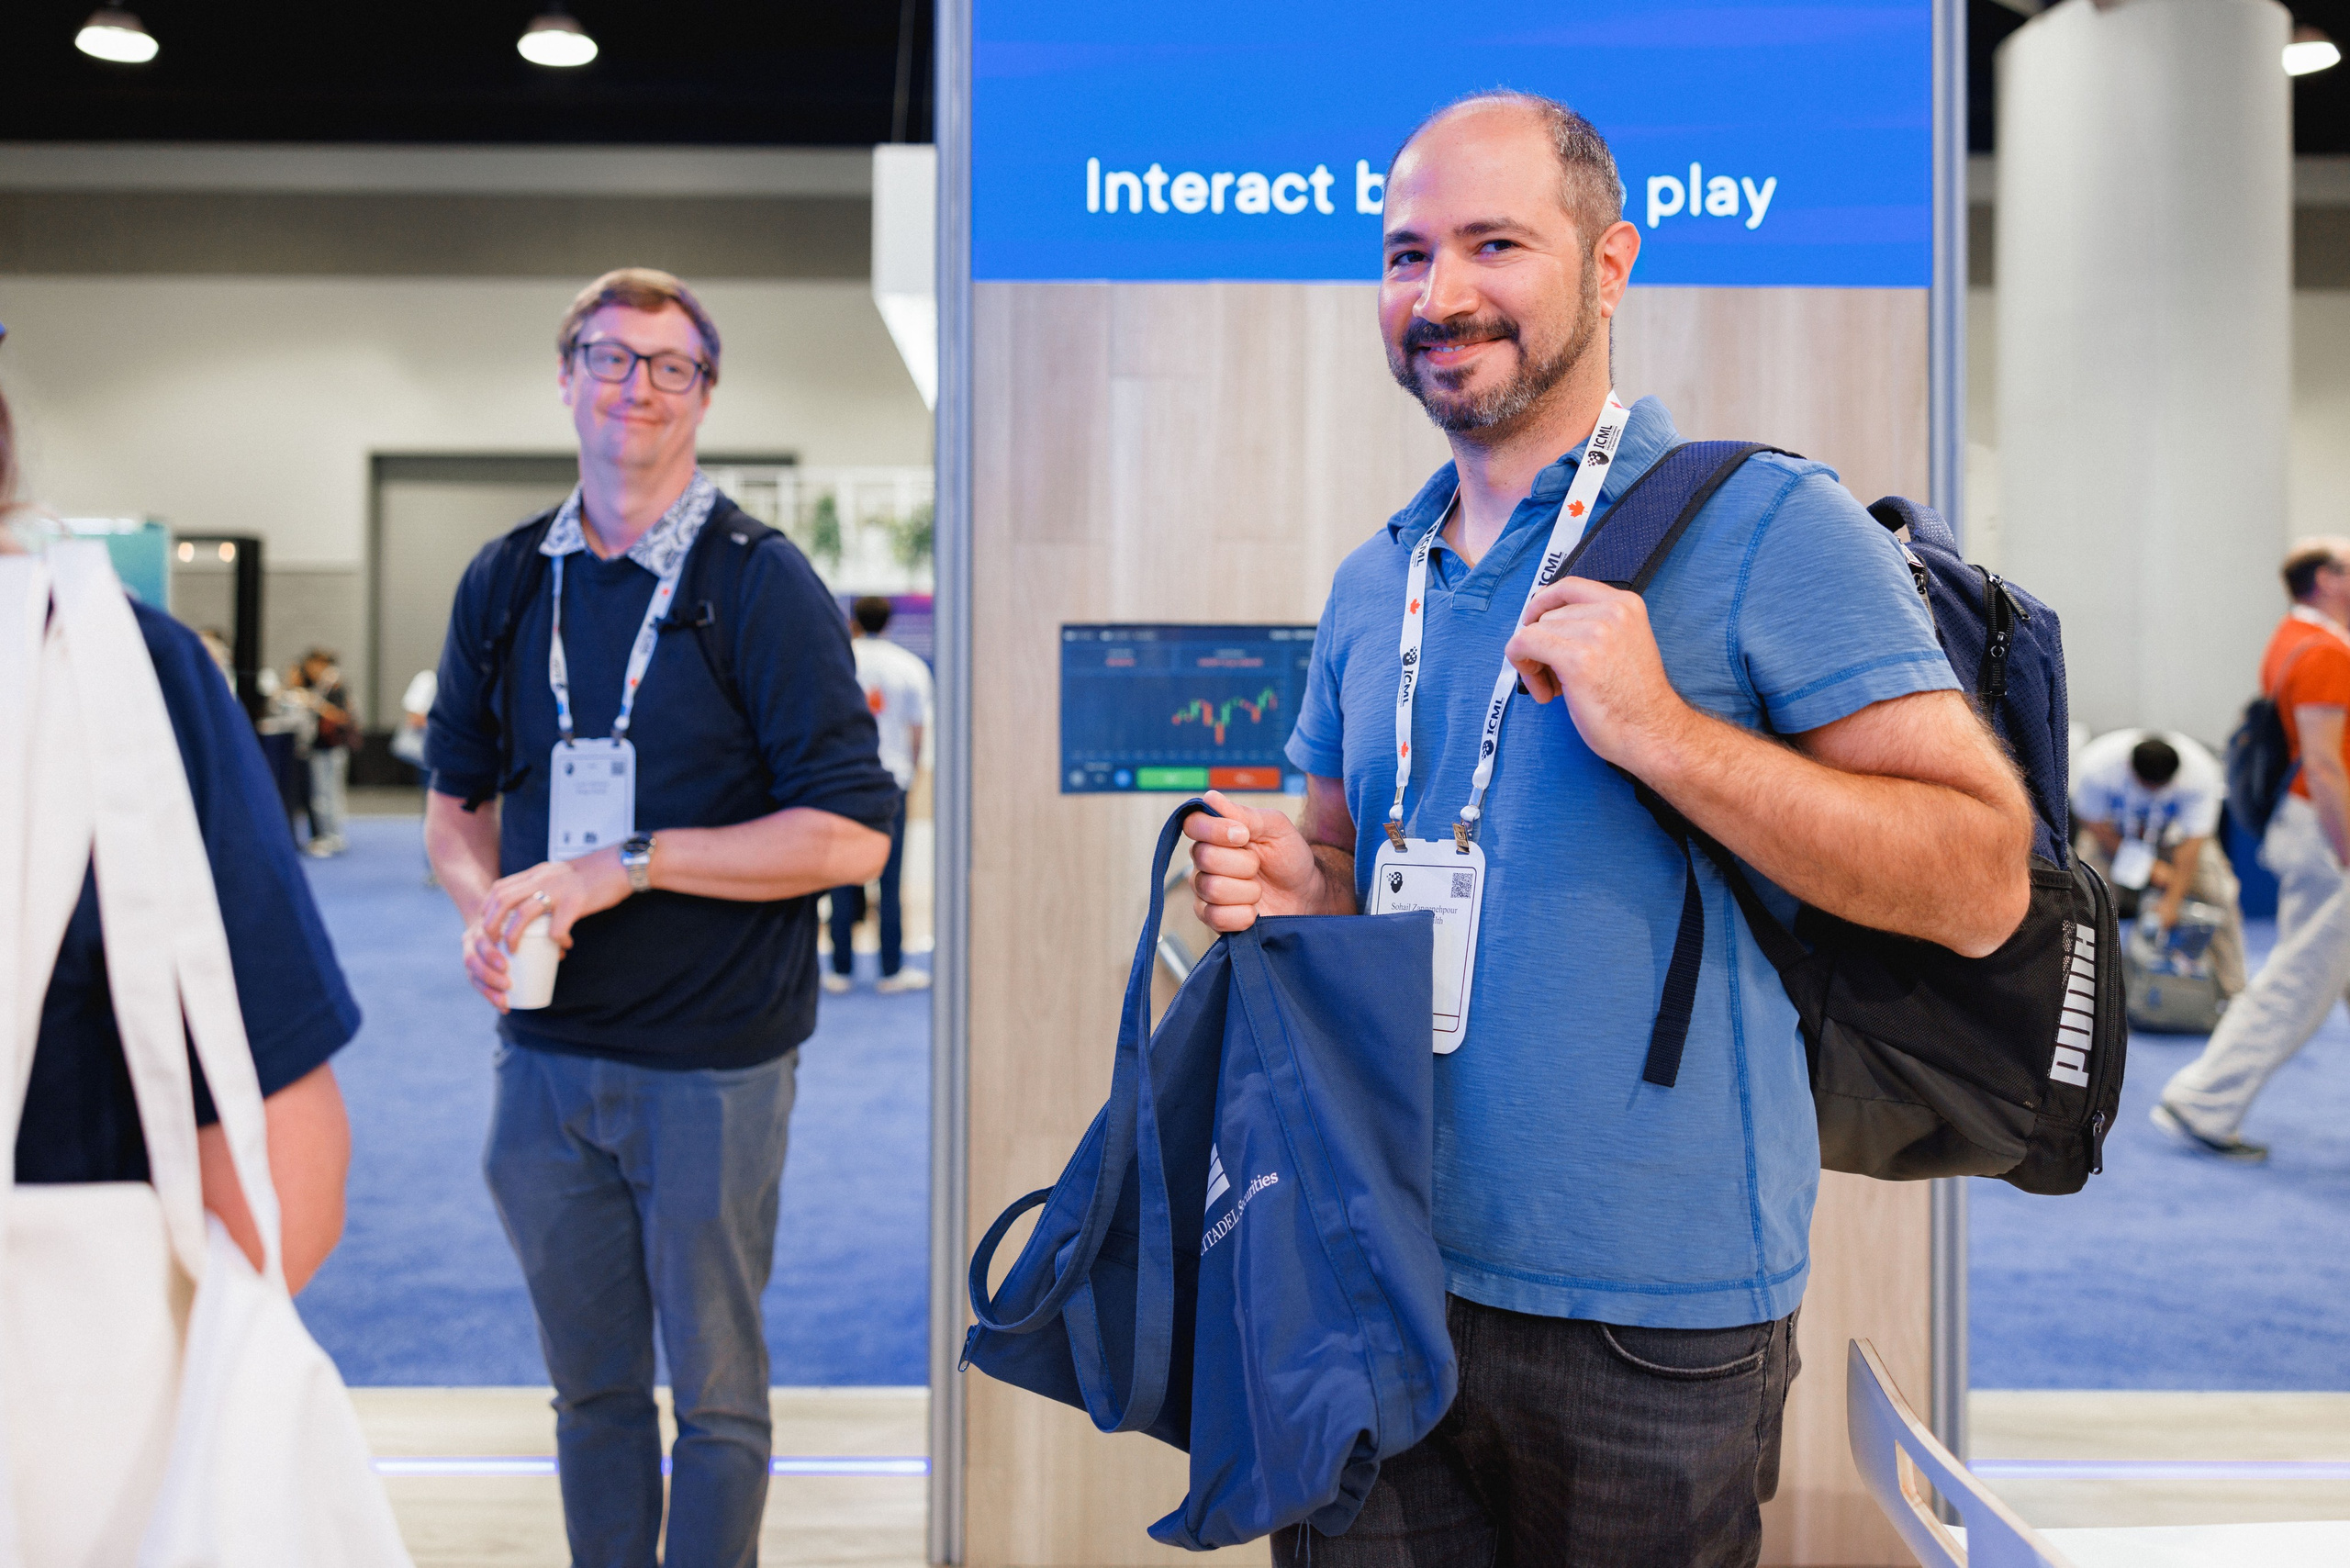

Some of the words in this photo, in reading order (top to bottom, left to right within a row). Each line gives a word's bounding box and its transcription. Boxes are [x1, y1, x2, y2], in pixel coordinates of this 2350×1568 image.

[1087, 157, 1335, 214] Interact
[1647, 162, 1778, 230] play
[1593, 425, 1613, 449] ICML
[1416, 534, 1432, 566] ICML
[1538, 552, 1562, 586] ICML
[1403, 669, 1414, 707] ICML
[1487, 697, 1505, 735] ICML
[2049, 924, 2096, 1088] PUMA
